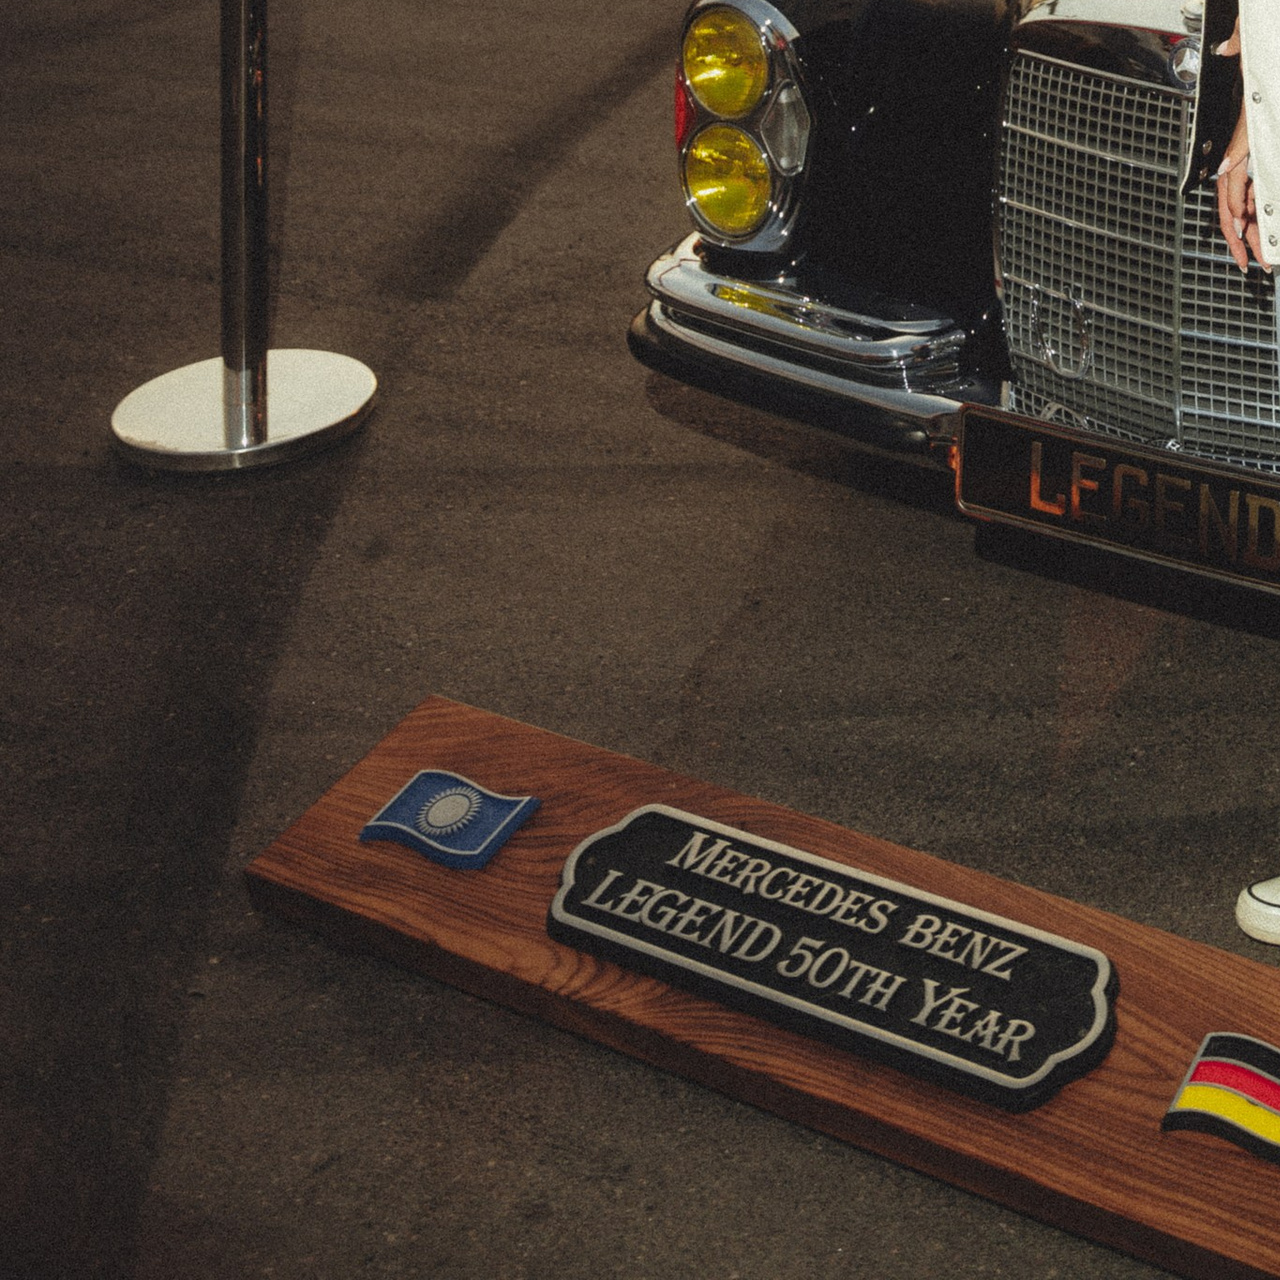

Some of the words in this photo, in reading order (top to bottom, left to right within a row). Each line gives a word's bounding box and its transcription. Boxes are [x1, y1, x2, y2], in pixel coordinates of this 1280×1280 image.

[581, 869, 782, 962] LEGEND
[776, 936, 908, 1012] 50TH
[910, 978, 1037, 1062] YEAR
[665, 830, 899, 935] MERCEDES
[898, 914, 1029, 981] BENZ
